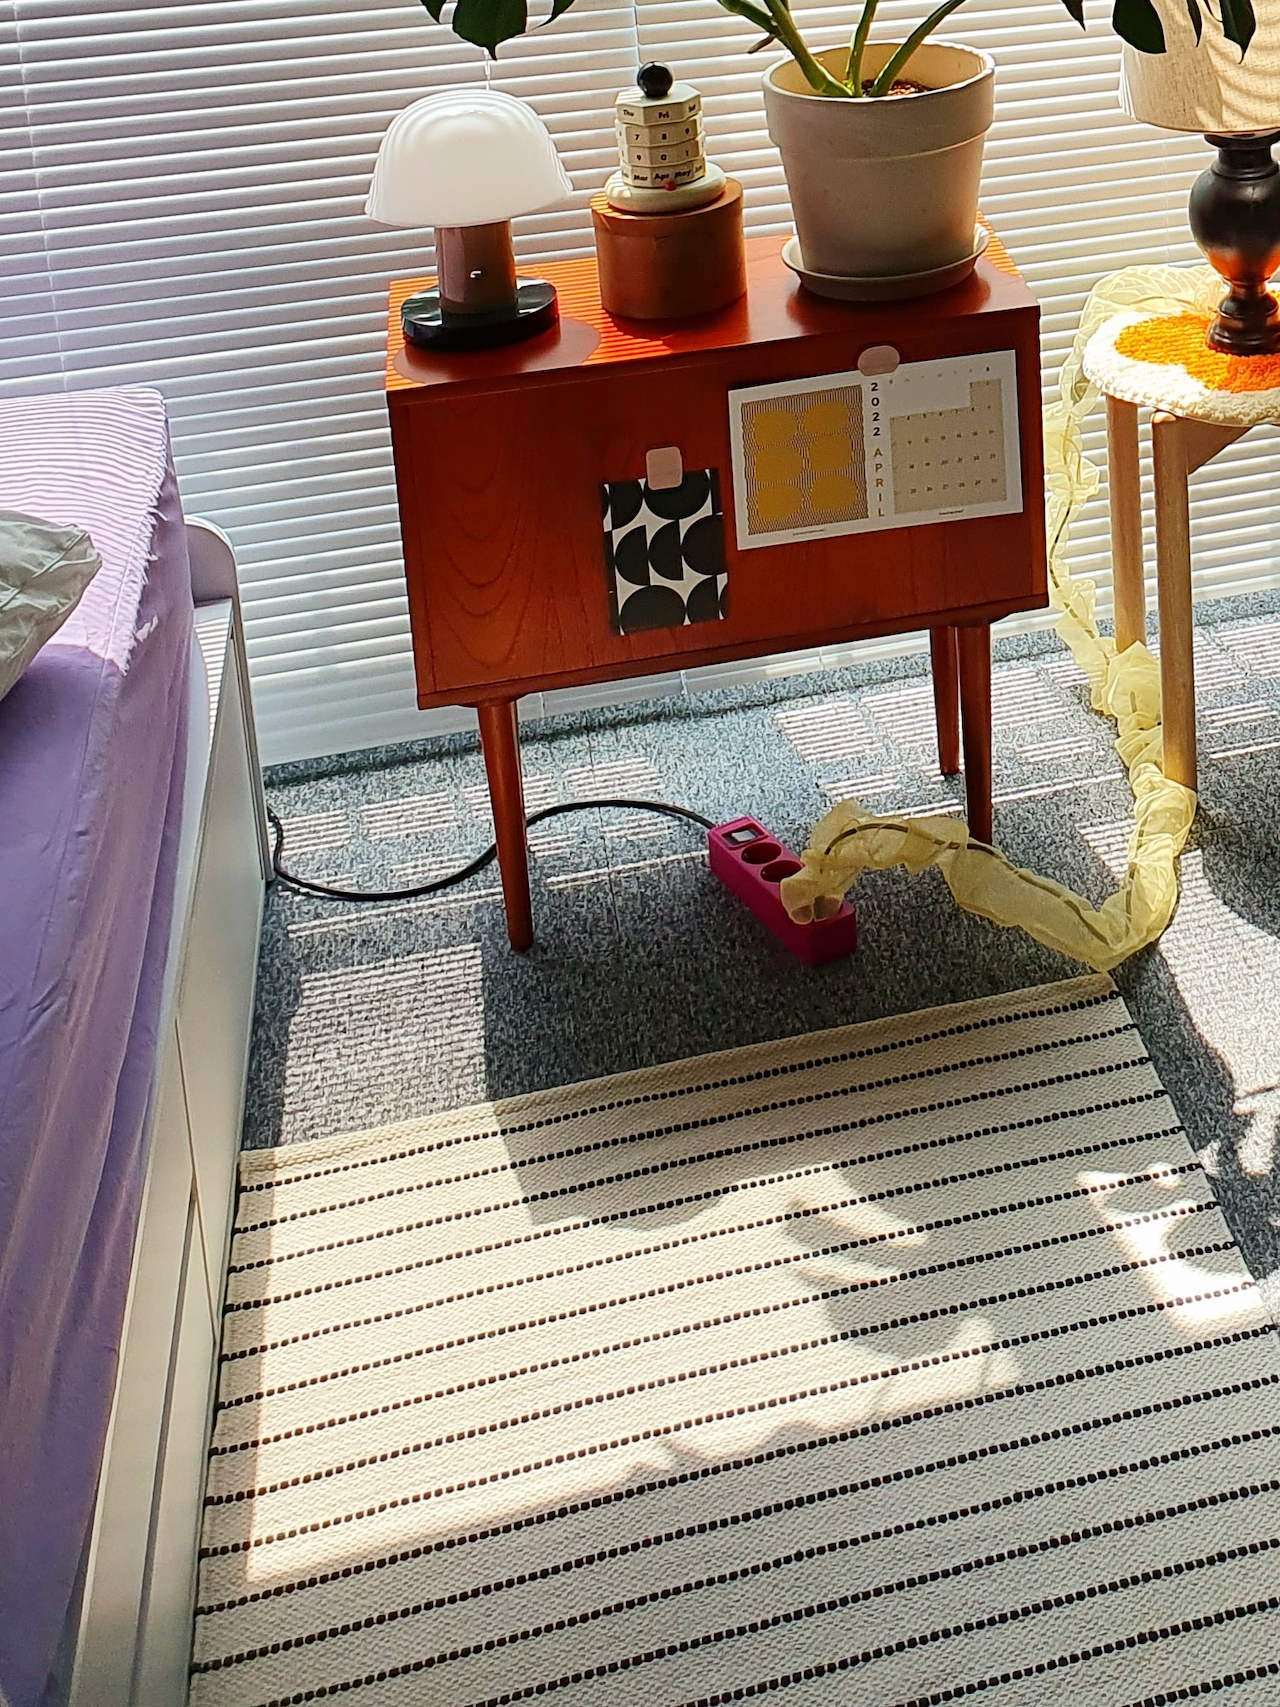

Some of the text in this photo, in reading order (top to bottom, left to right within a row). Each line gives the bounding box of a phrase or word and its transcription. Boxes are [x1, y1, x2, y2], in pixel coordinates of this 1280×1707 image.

[623, 109, 634, 117] Thu
[658, 111, 669, 119] Fri
[633, 174, 648, 182] Mar
[654, 173, 670, 181] Apr
[674, 170, 692, 178] May
[871, 382, 881, 437] 2022
[873, 448, 885, 517] APRIL
